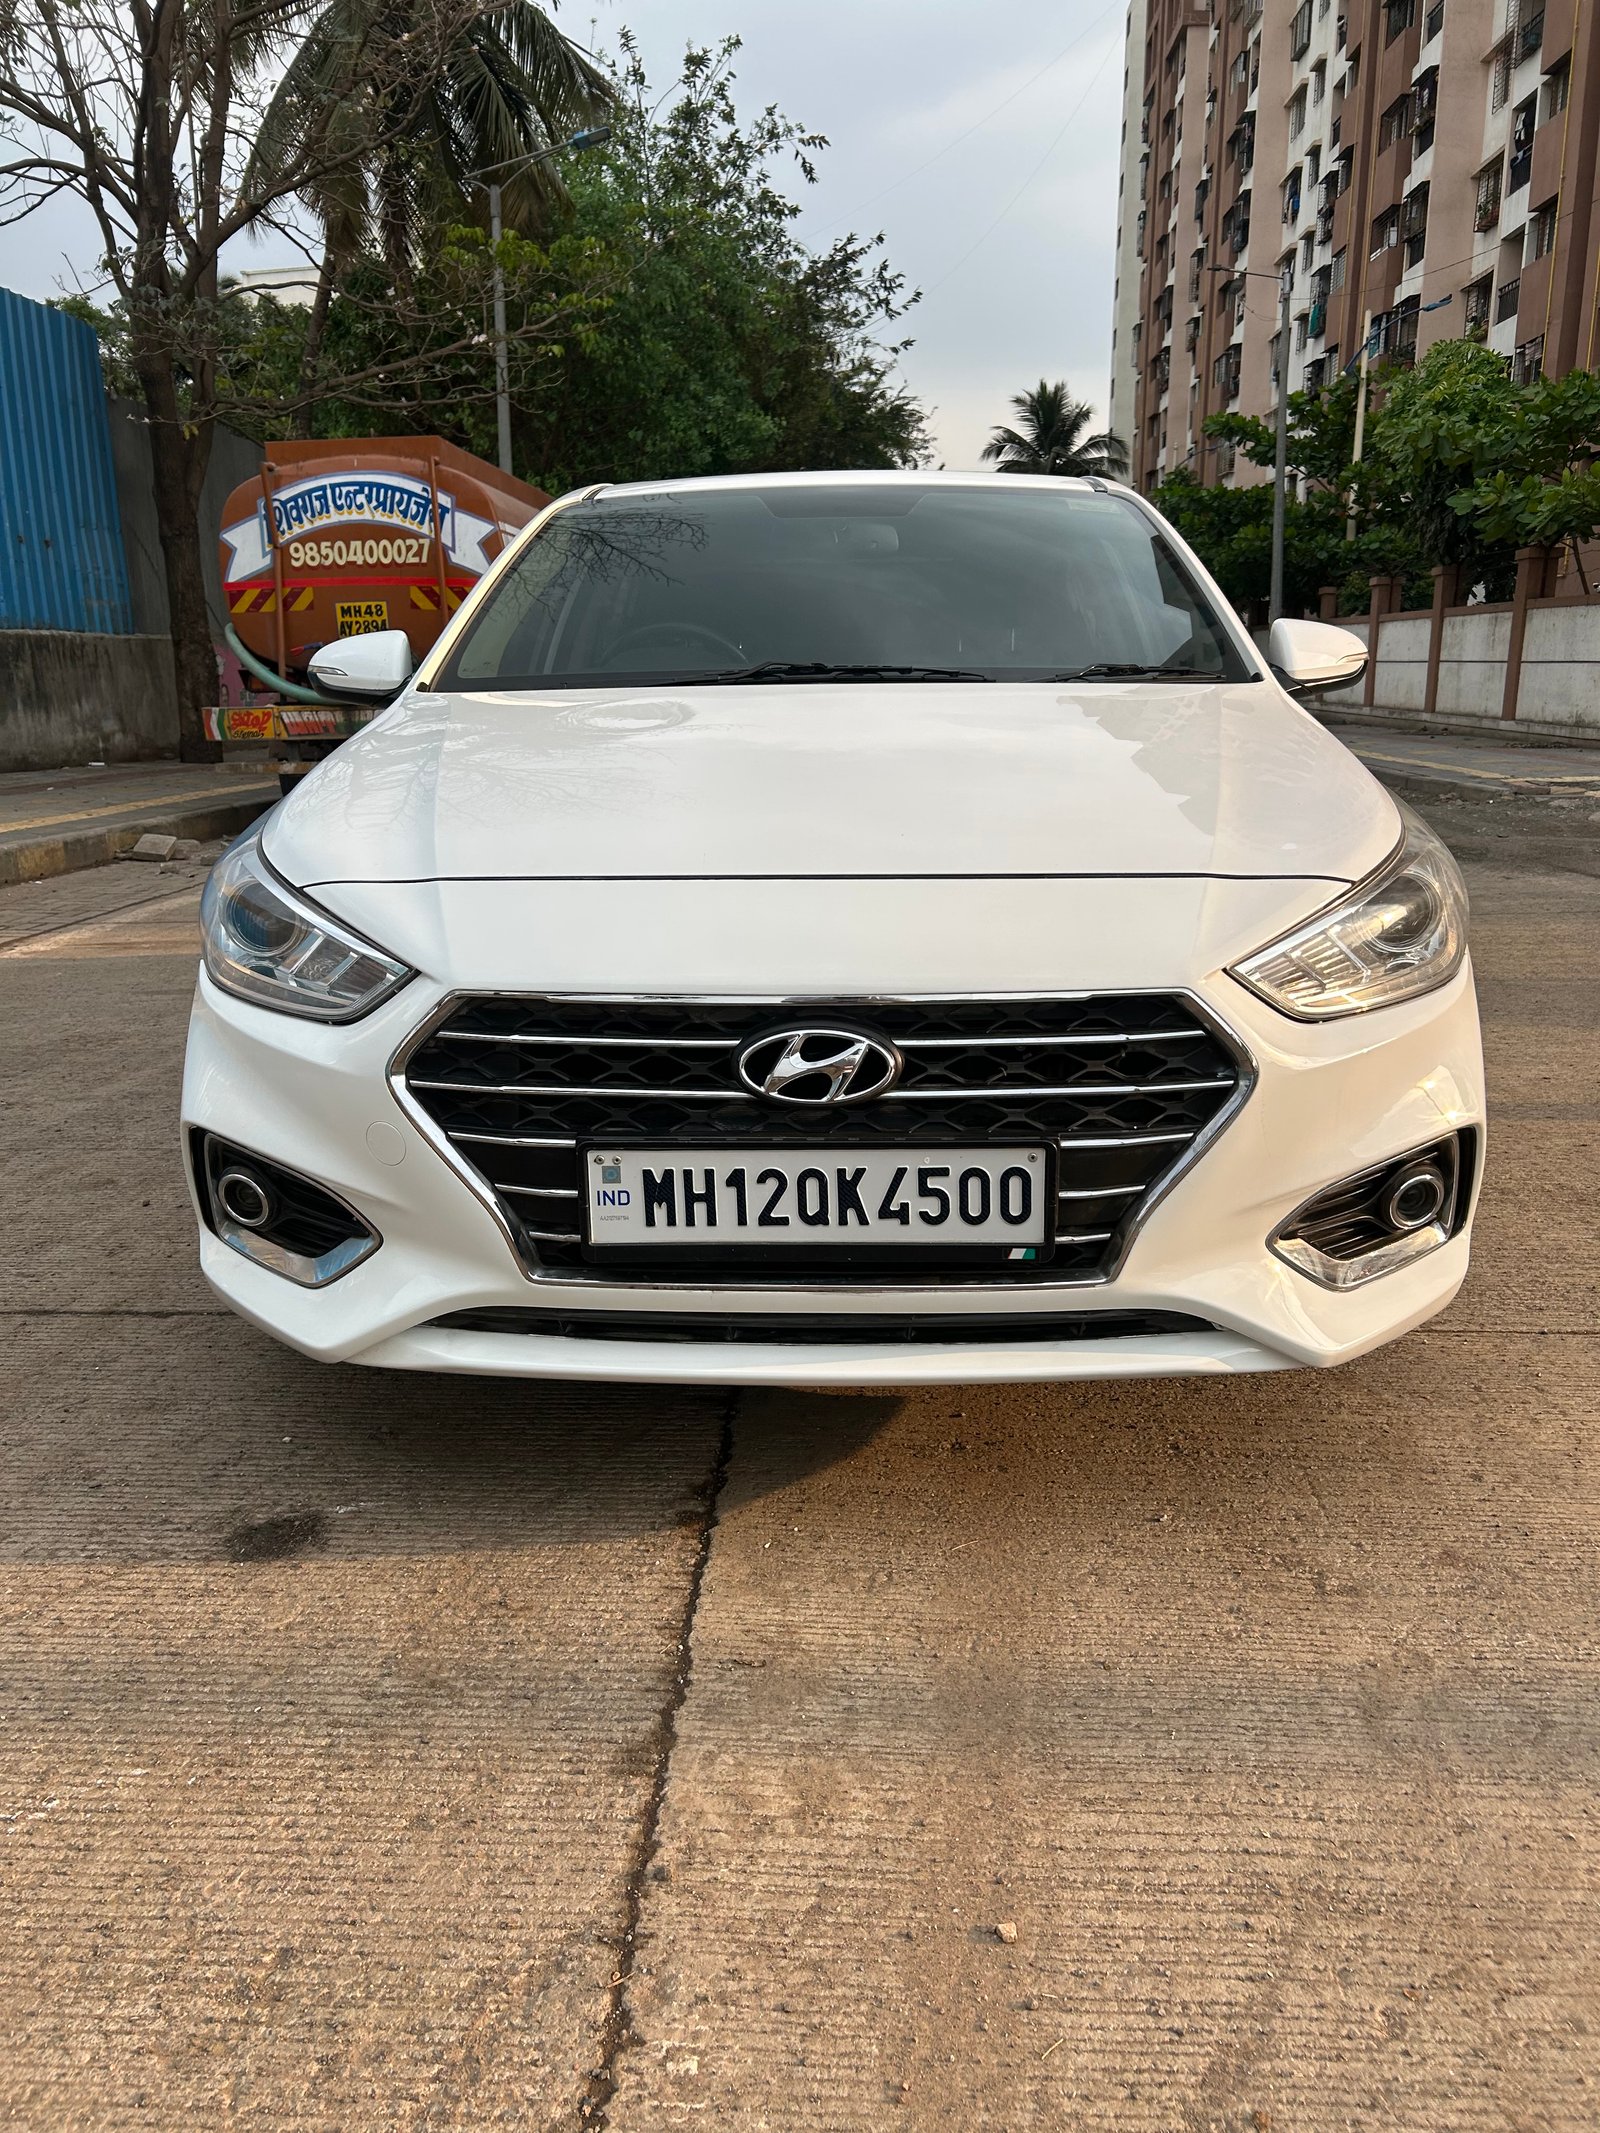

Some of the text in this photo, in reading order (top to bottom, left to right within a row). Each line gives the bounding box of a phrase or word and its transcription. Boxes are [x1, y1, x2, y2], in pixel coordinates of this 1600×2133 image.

[289, 538, 431, 568] 9850400027
[597, 1190, 630, 1206] IND
[642, 1166, 1033, 1228] MH12QK4500
